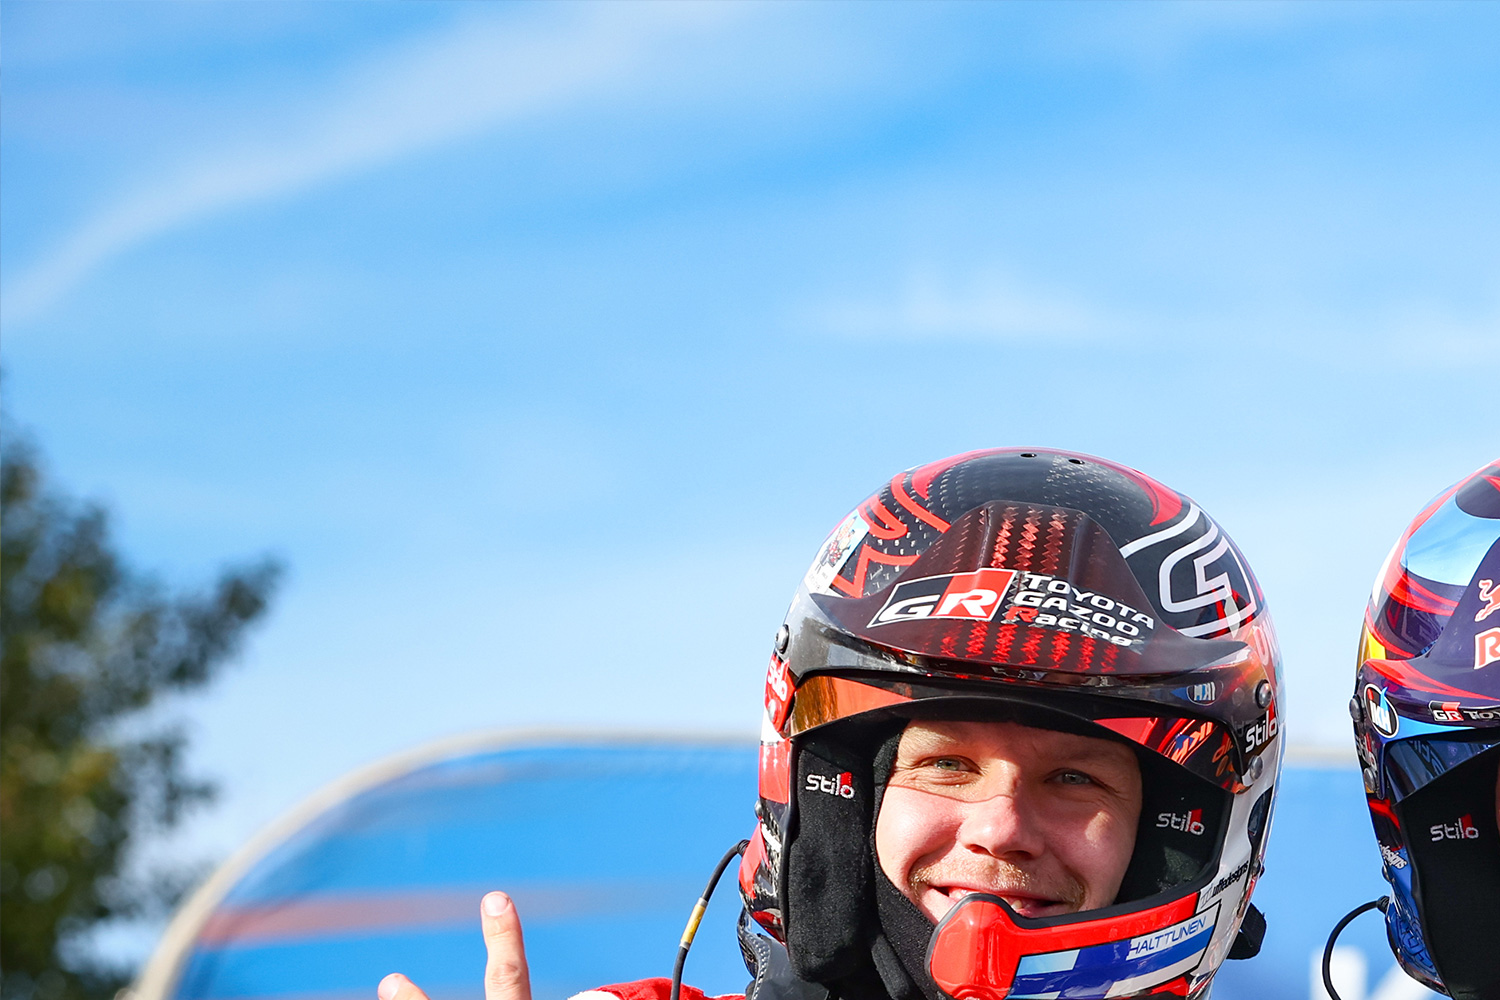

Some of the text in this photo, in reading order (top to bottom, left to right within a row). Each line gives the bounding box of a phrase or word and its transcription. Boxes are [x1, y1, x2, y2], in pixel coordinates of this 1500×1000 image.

[879, 589, 998, 622] GR
[1014, 592, 1139, 637] GAZOO
[1023, 573, 1155, 630] TOYOTA
[1004, 606, 1133, 647] Racing
[1432, 709, 1464, 721] GR
[1130, 916, 1207, 954] HALTTUNEN
